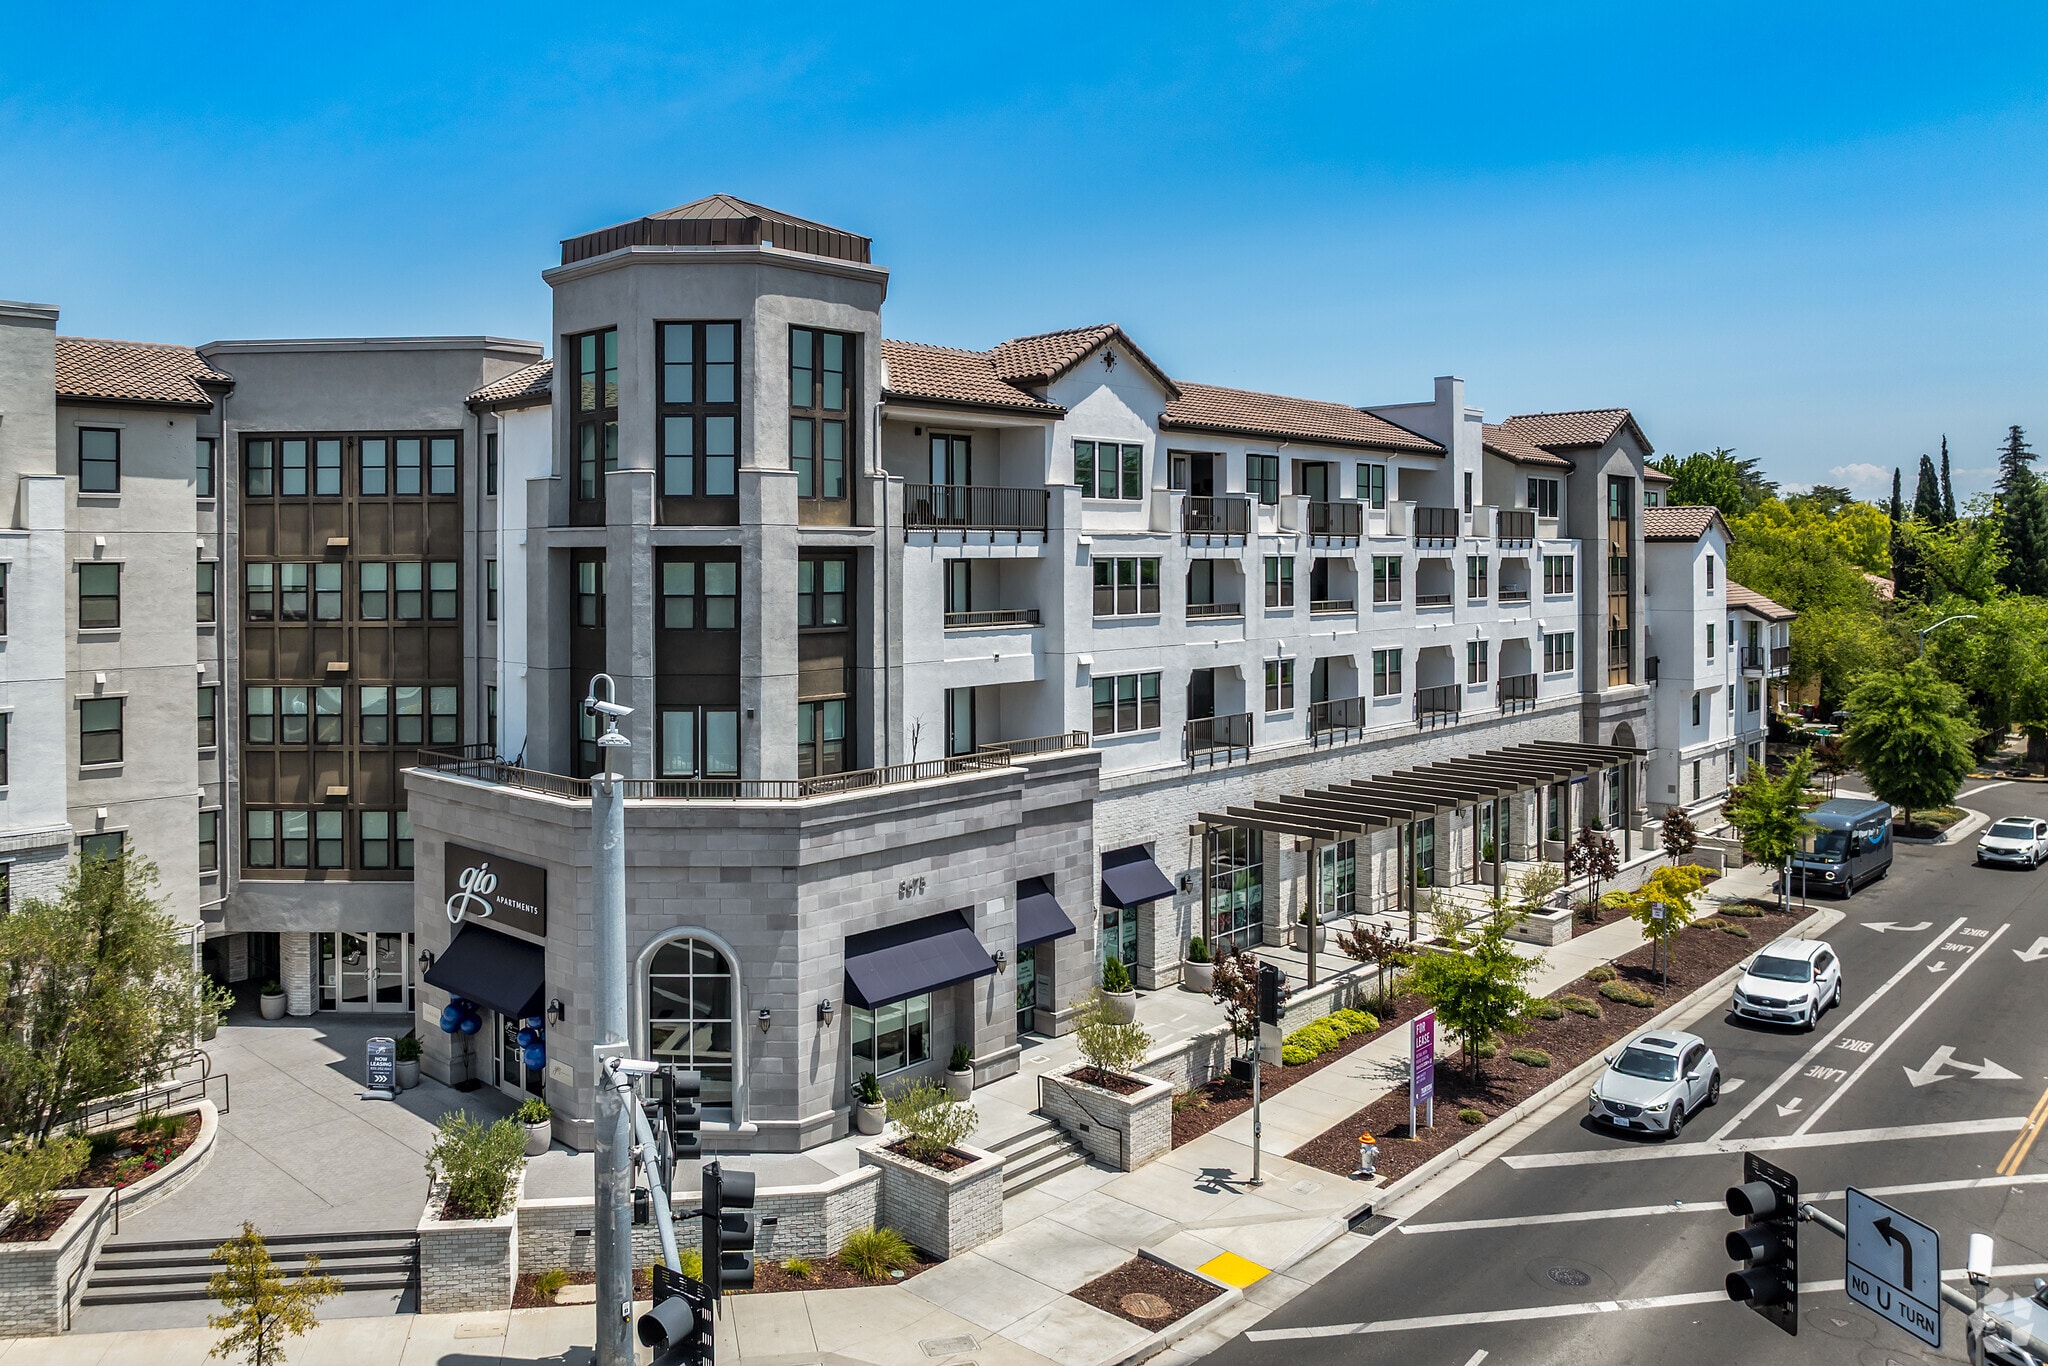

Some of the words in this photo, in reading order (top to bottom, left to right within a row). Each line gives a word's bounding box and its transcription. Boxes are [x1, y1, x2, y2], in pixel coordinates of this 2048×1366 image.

[446, 862, 497, 924] gio
[496, 895, 539, 915] APARTMENTS
[1959, 927, 1990, 938] BIKE
[1940, 942, 1975, 954] LANE
[1416, 1022, 1426, 1035] FOR
[1416, 1033, 1430, 1048] LEASE
[1834, 1037, 1875, 1054] BIKE
[1804, 1065, 1848, 1083] LANE
[1852, 1275, 1869, 1296] NO
[1877, 1286, 1891, 1311] U
[1898, 1301, 1935, 1336] TURN
